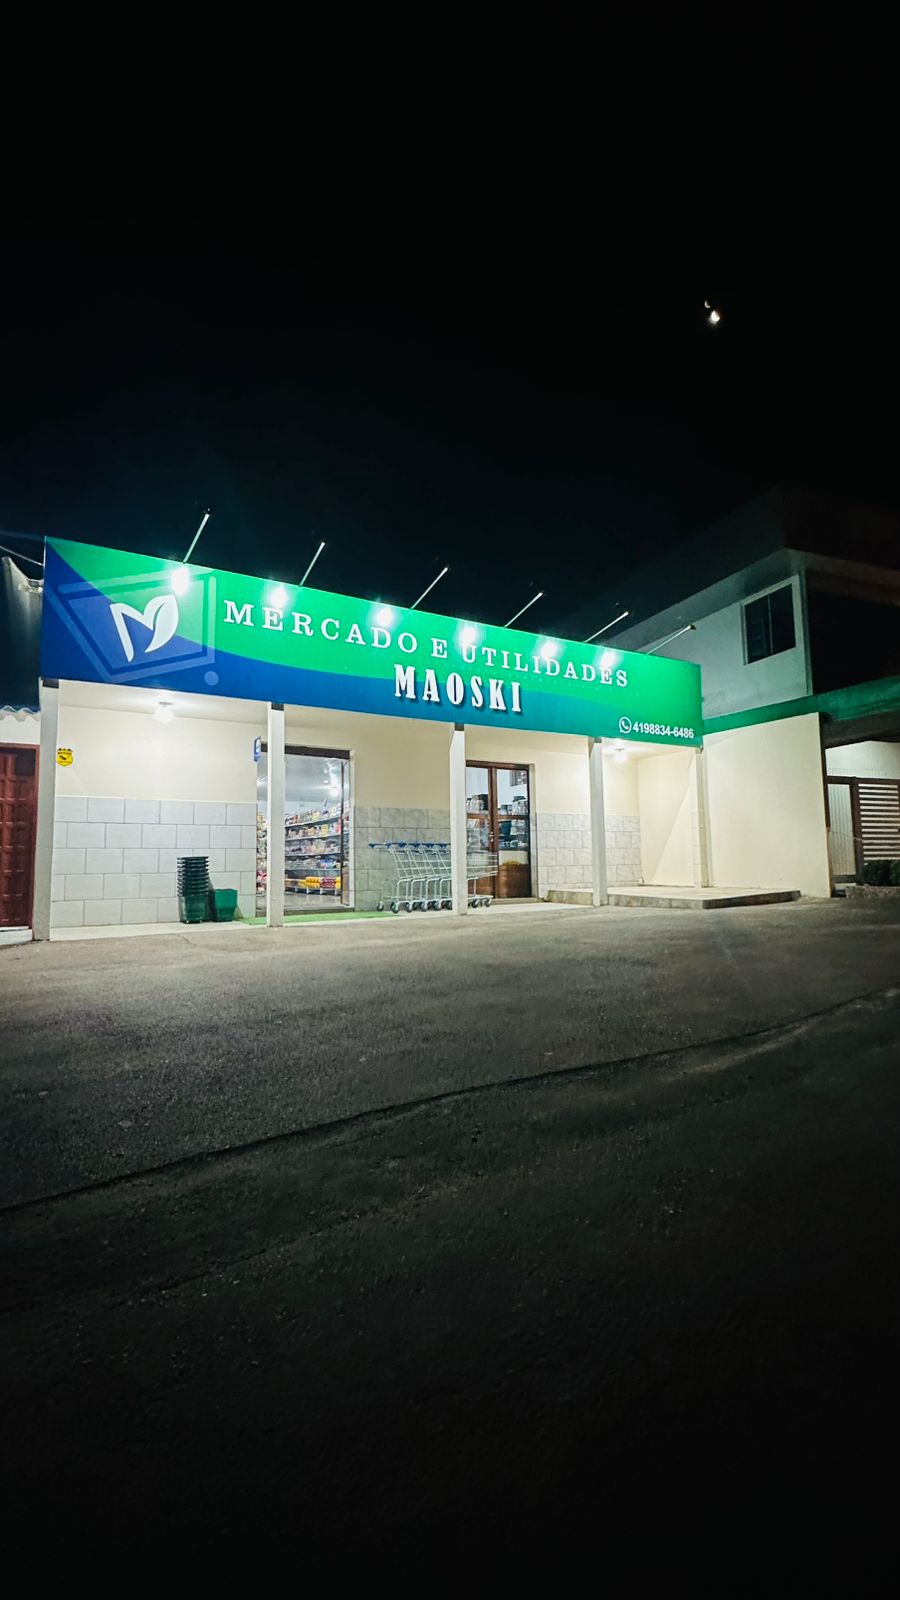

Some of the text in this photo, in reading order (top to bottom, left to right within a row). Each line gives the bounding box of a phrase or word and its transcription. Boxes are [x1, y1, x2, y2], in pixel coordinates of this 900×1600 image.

[223, 600, 628, 688] MERCADO E UTILIDADES
[394, 664, 522, 712] MAOSKI
[633, 721, 695, 739] 4198834-6486
